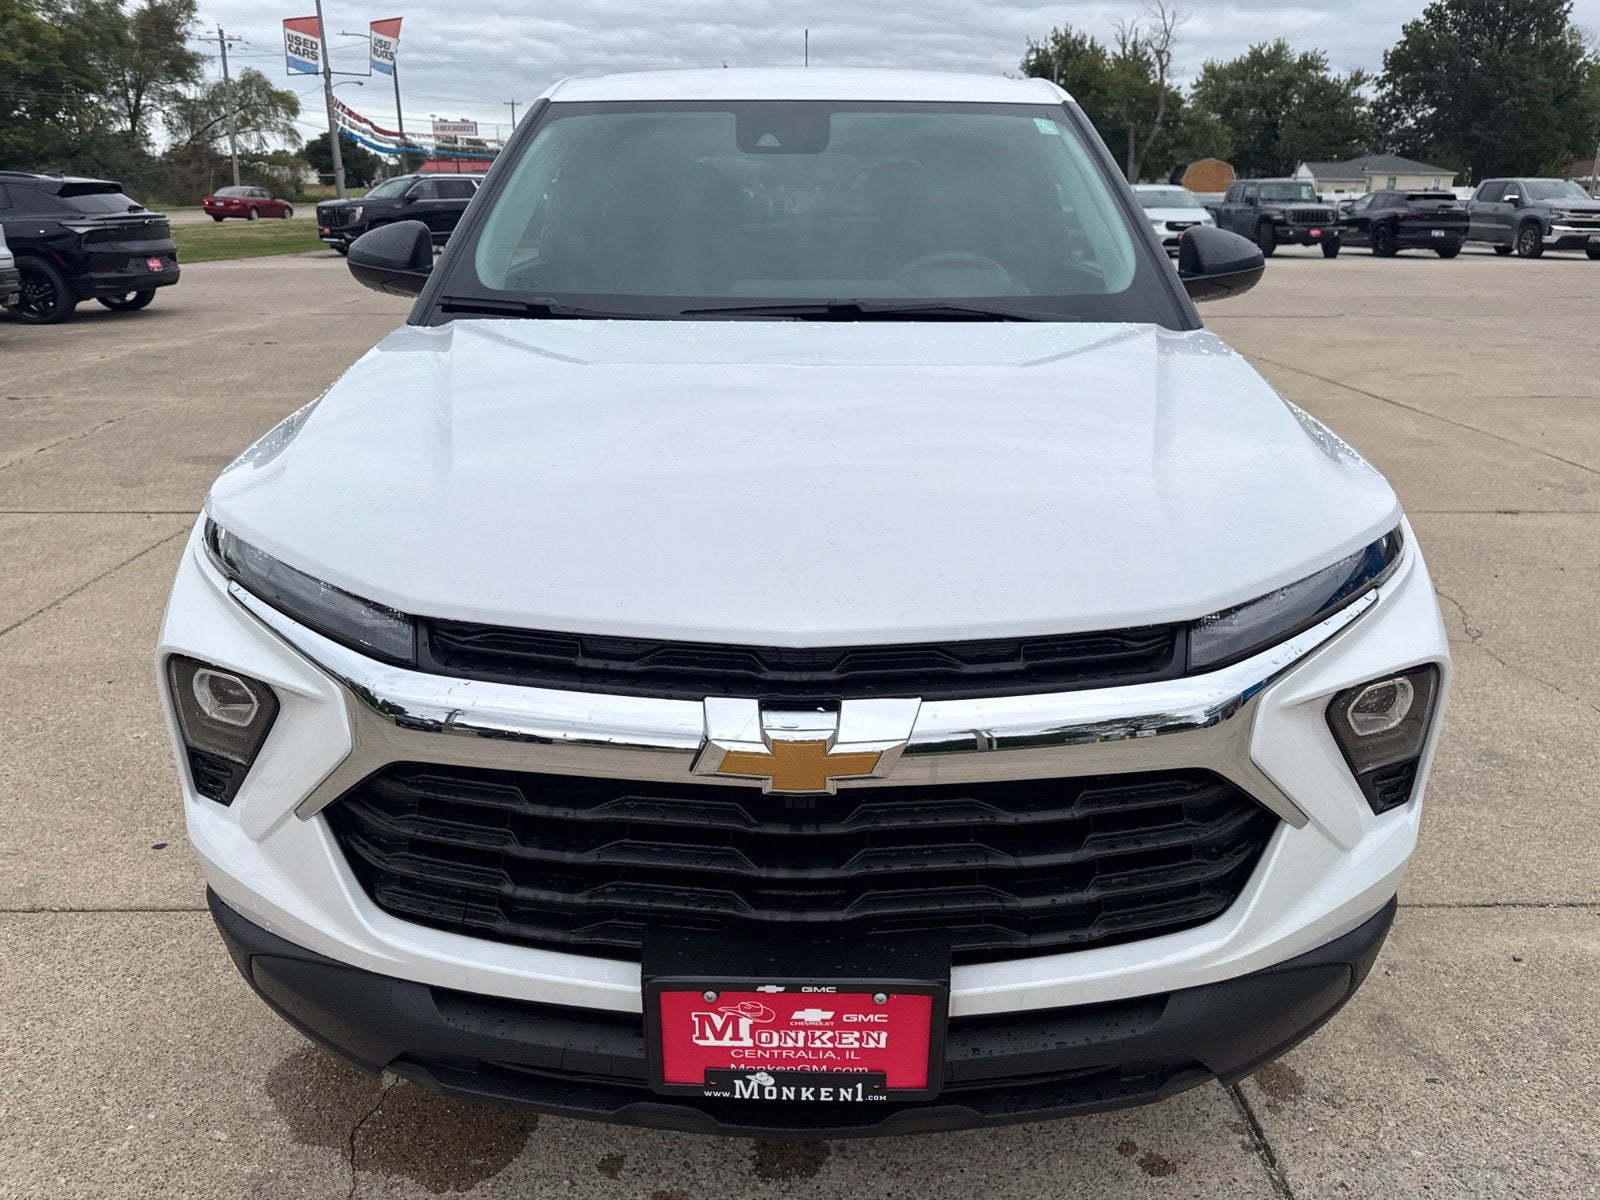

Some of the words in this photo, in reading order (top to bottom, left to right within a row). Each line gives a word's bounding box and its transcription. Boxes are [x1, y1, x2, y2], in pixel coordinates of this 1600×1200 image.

[287, 33, 318, 50] USED
[288, 43, 319, 61] CARS
[842, 1013, 889, 1023] GMC
[692, 1012, 888, 1049] MONKEN
[730, 1049, 842, 1061] CENTRALIA,
[845, 1051, 862, 1060] IL
[730, 1063, 869, 1073] MonkenGMcom
